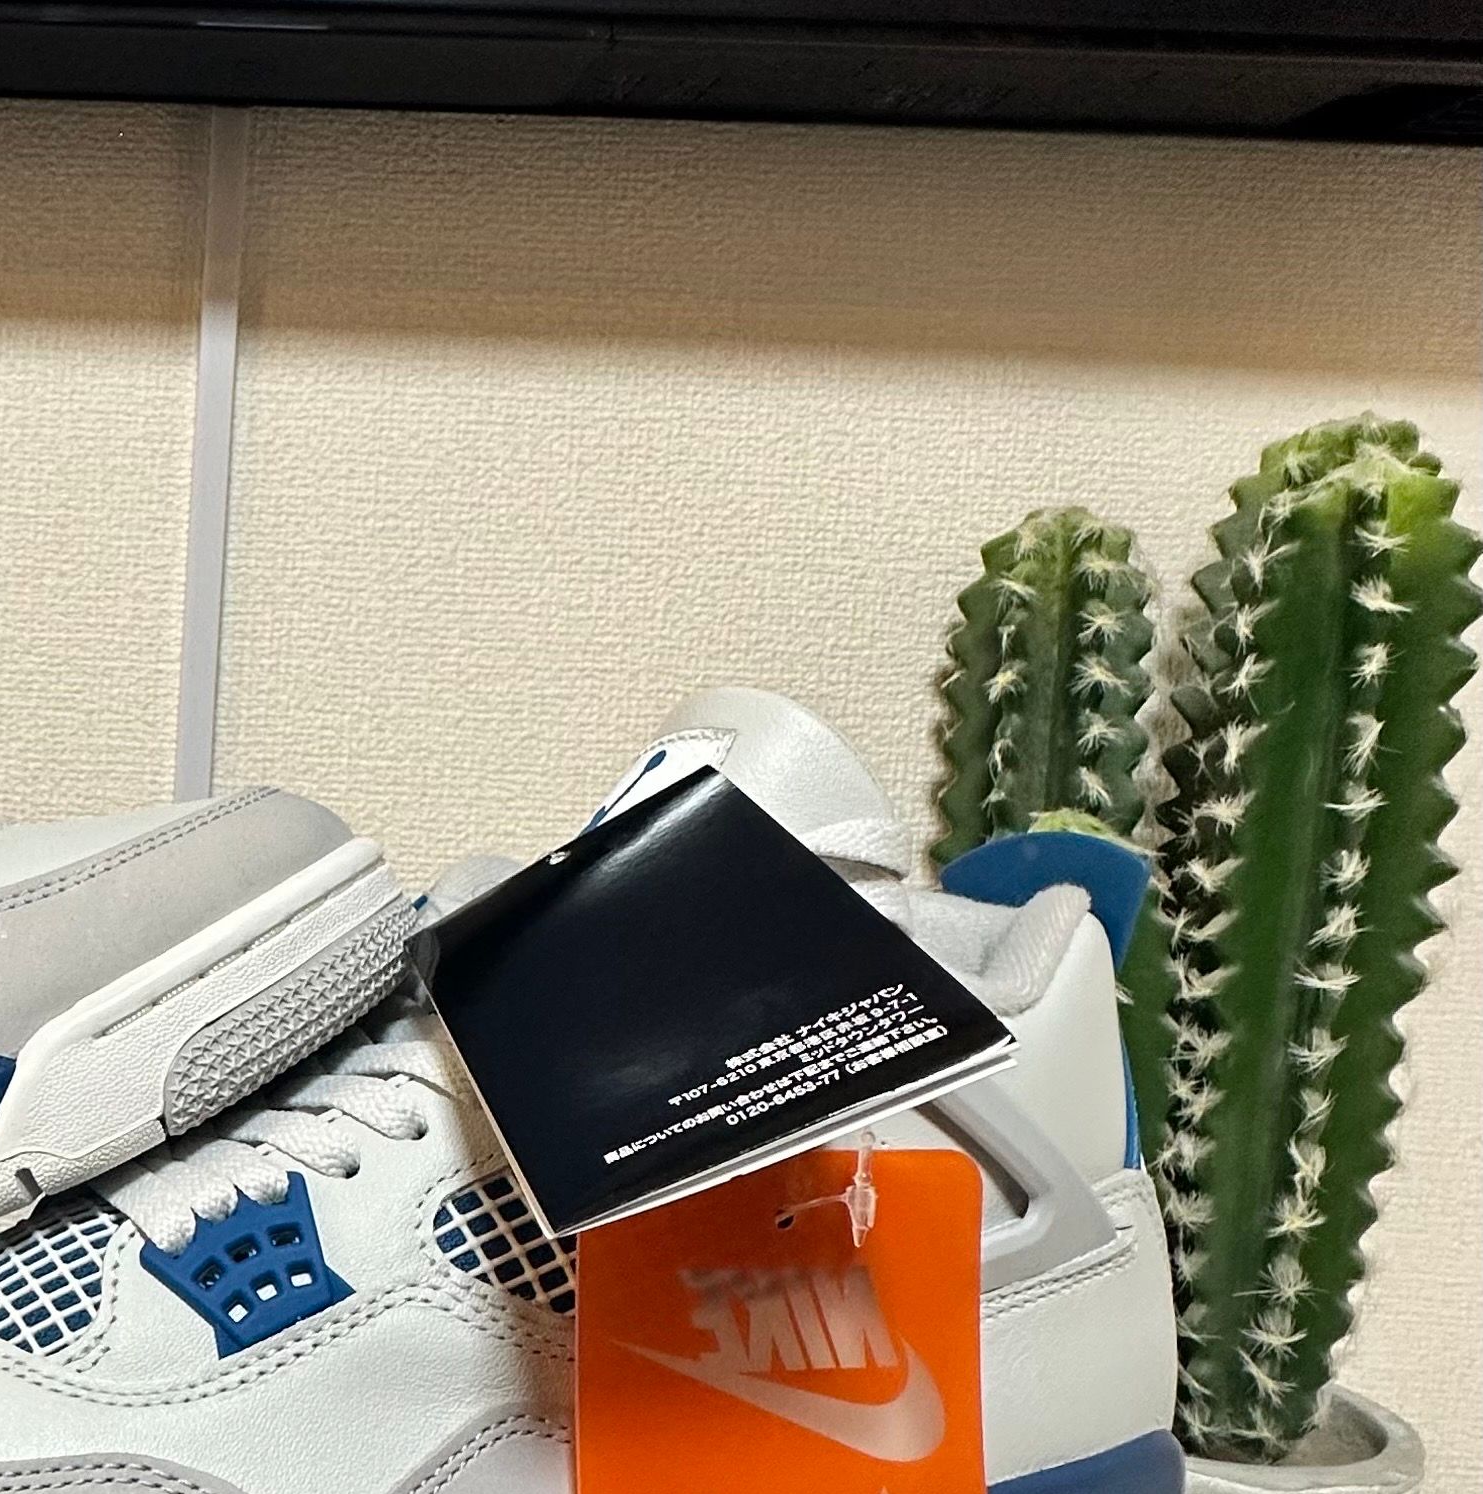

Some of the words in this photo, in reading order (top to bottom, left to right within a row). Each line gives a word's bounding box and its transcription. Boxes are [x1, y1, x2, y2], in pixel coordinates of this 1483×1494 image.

[724, 1033, 794, 1069] 株式会社
[795, 983, 903, 1037] ナイキジャパン
[798, 1004, 924, 1062] ミッドタウンタワー
[725, 1068, 839, 1125] 0120-6453-77
